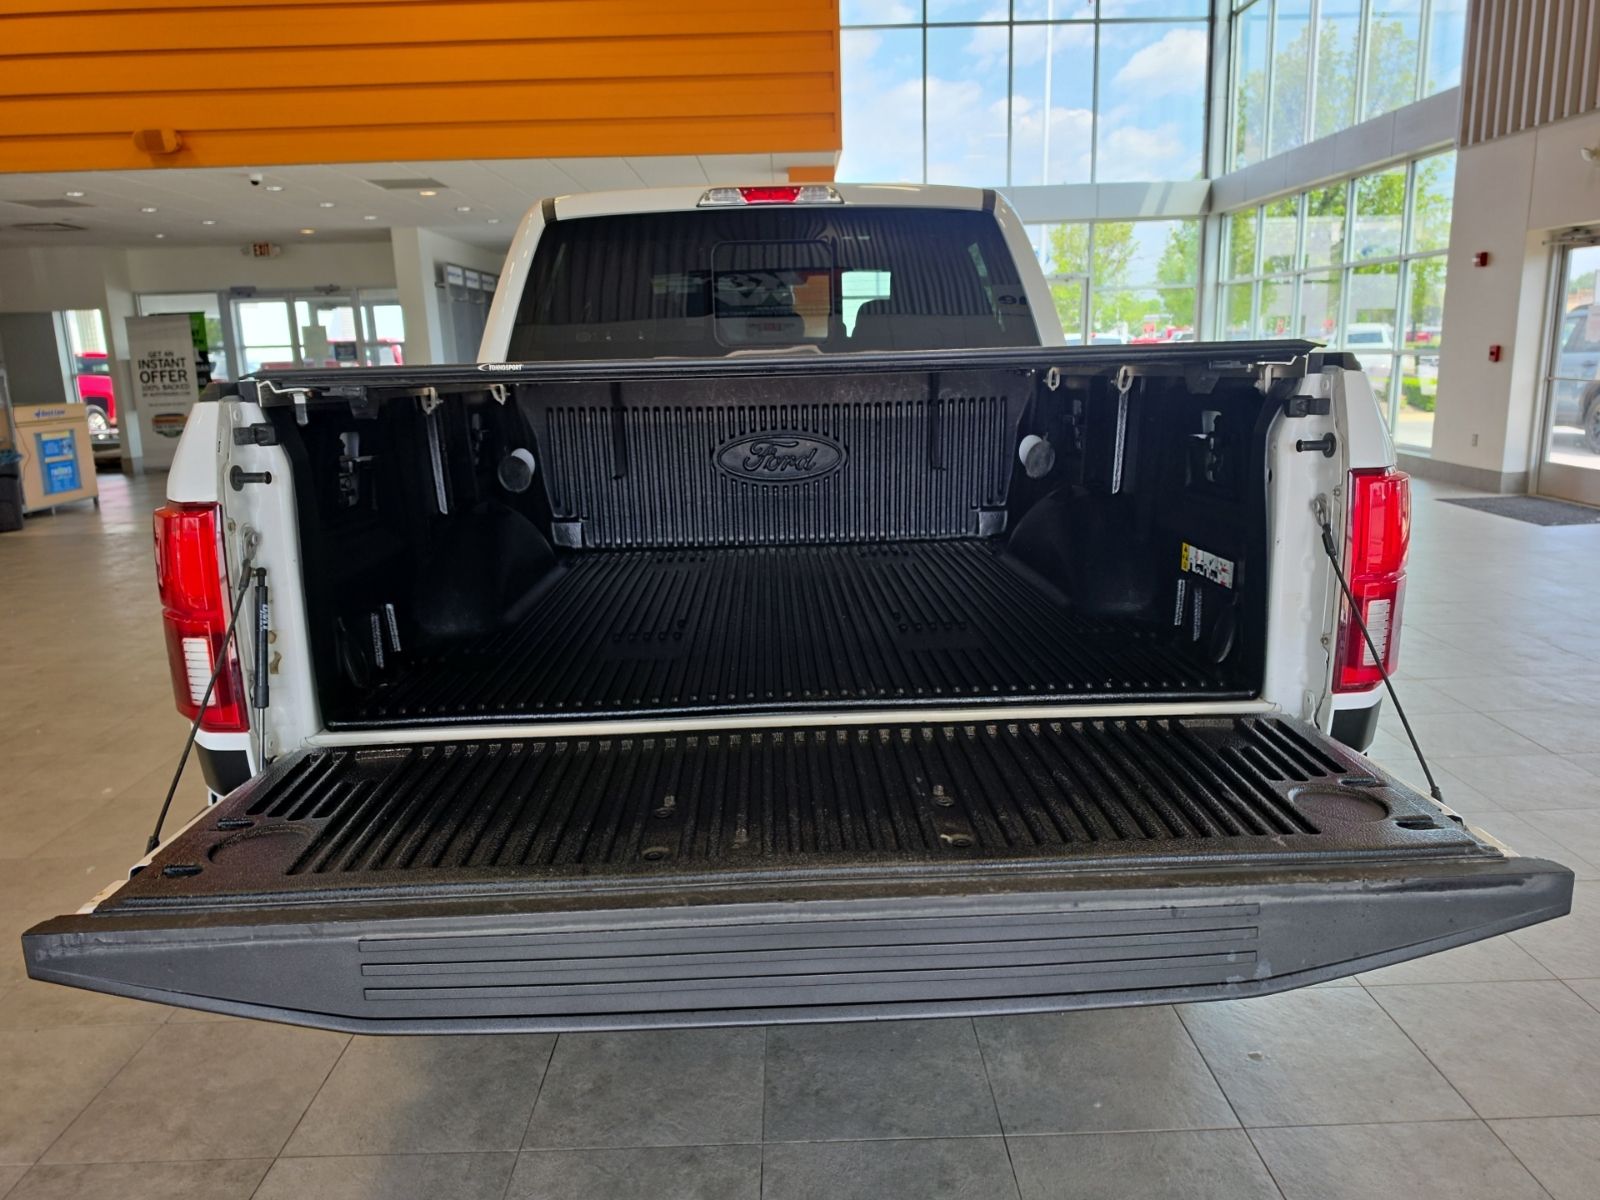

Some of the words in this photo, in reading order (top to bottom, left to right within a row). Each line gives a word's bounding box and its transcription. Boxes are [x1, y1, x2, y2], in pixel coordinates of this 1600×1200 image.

[253, 243, 270, 257] EXIT
[138, 358, 185, 369] INSTANT
[140, 369, 188, 384] OFFER
[743, 440, 818, 472] Ford
